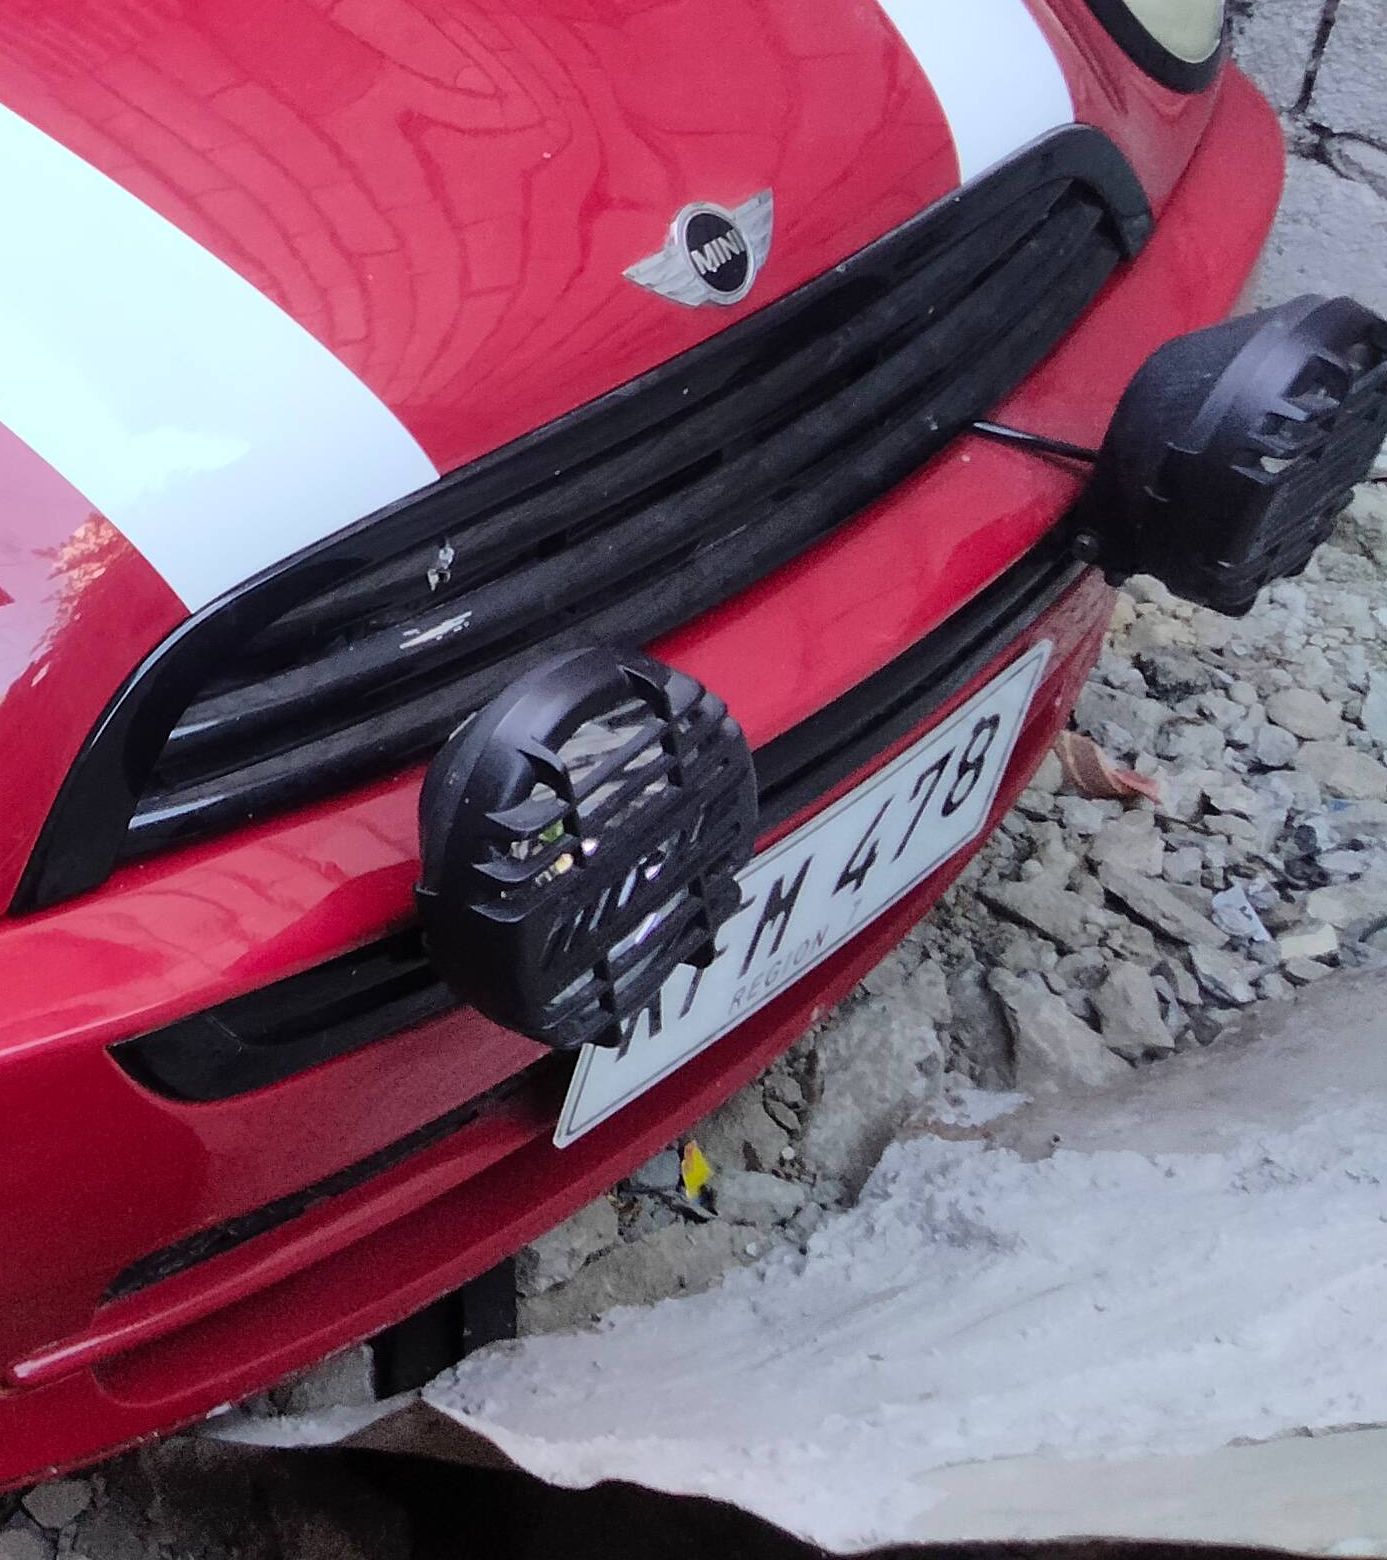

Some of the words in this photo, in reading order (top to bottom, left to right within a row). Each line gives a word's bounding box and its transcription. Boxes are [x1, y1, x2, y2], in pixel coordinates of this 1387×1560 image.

[690, 229, 746, 275] MINI
[831, 712, 1001, 898] 478
[728, 923, 830, 1015] REGION
